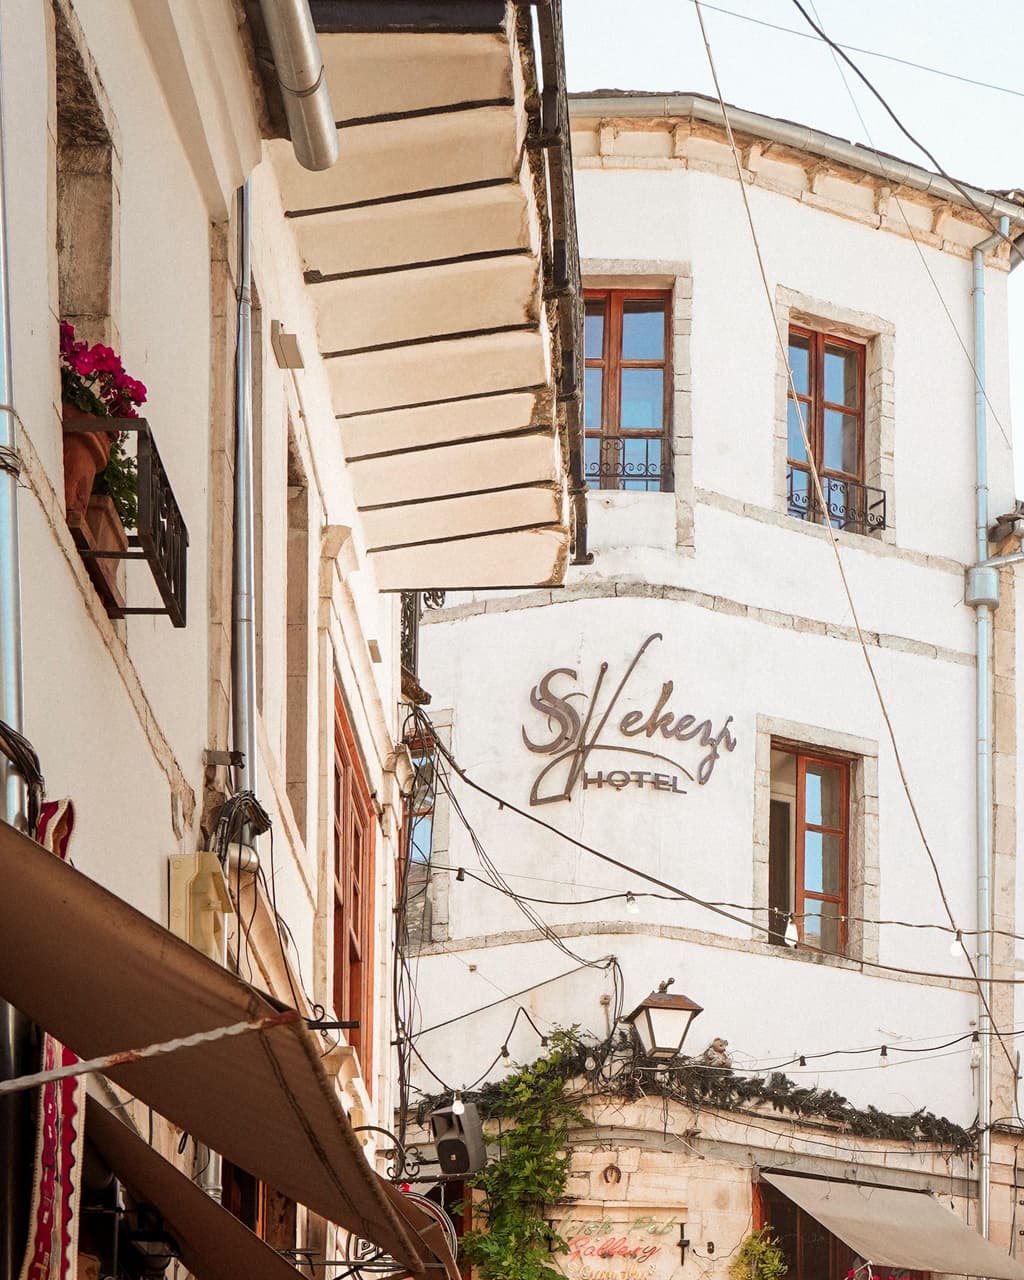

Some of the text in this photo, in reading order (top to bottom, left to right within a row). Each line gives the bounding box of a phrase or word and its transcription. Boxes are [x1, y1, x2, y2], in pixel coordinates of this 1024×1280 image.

[582, 770, 688, 795] HOTEL
[628, 1215, 678, 1236] Pub
[568, 1236, 662, 1263] Gallery
